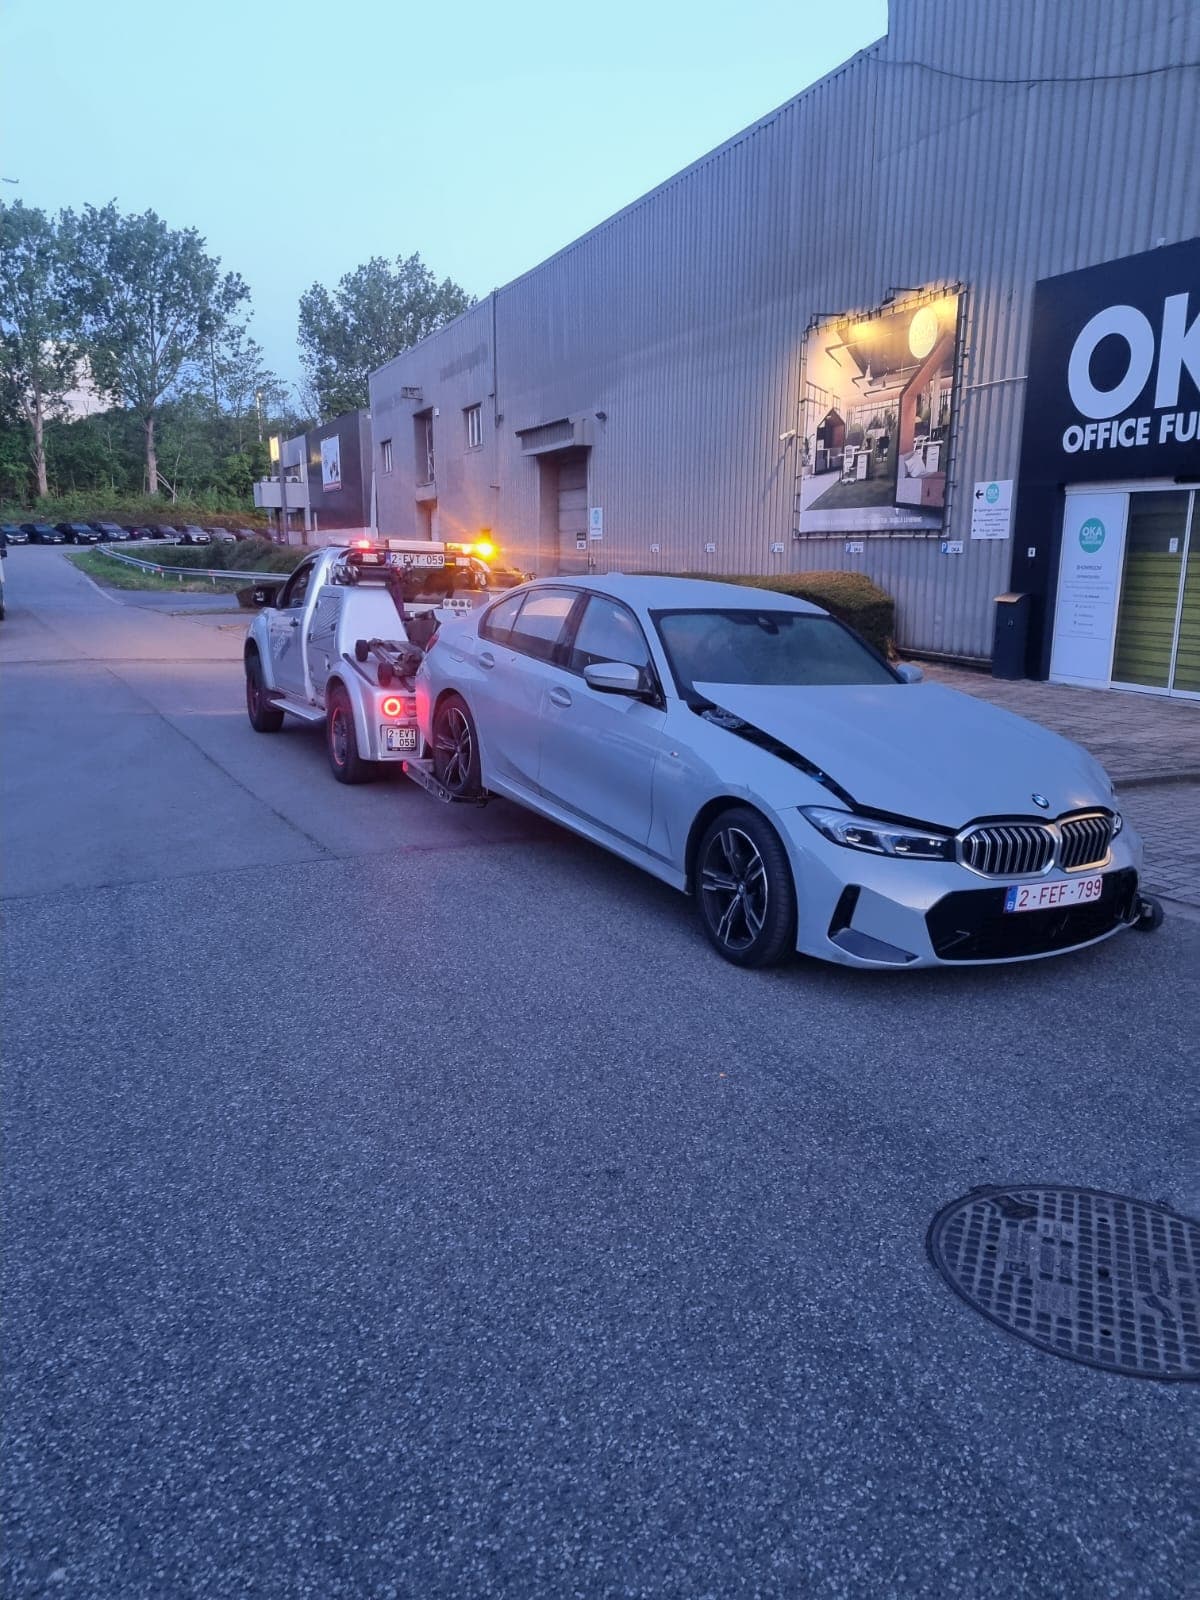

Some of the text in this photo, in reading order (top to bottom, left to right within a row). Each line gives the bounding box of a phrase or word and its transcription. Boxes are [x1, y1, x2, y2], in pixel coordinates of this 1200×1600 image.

[1062, 410, 1200, 453] OFFICE FU
[1082, 526, 1103, 537] OKA
[399, 738, 415, 747] 059
